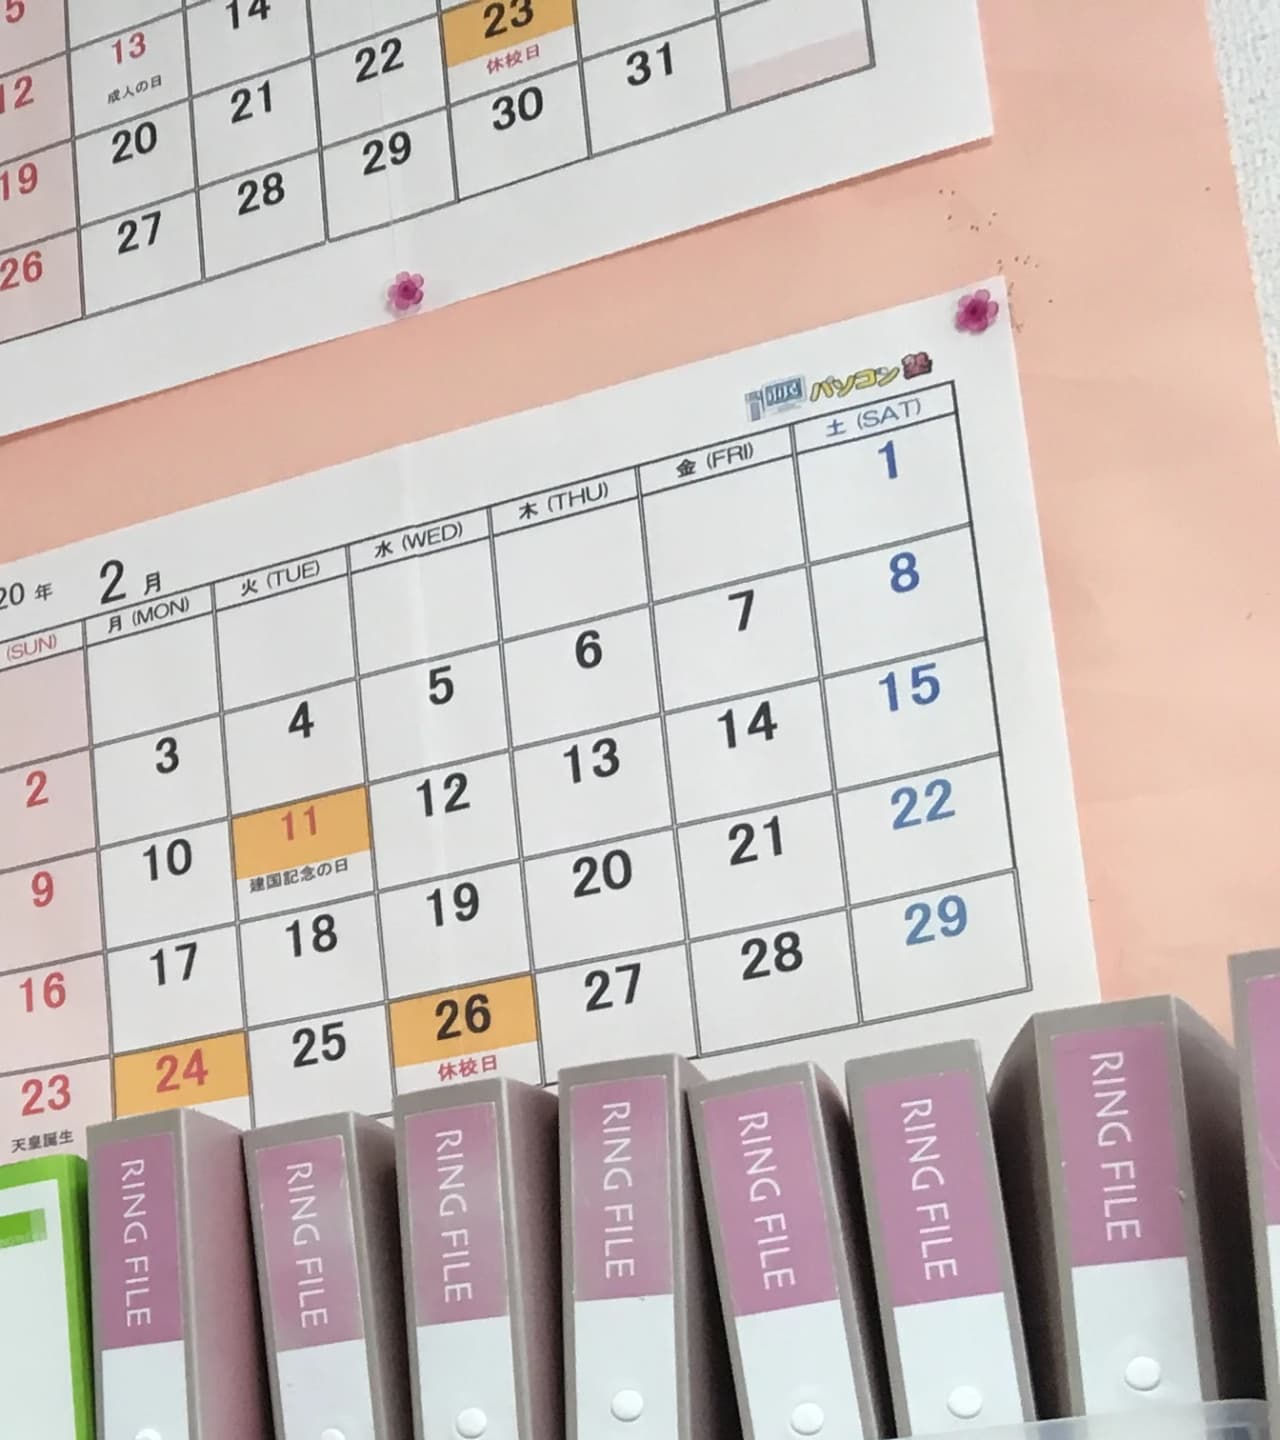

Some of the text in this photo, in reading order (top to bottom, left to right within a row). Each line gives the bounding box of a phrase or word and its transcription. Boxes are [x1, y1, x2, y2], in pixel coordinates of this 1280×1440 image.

[5, 0, 25, 24] 5
[228, 0, 271, 30] 14
[483, 0, 535, 39] 23
[111, 33, 146, 65] 13
[355, 38, 404, 83] 22
[485, 44, 541, 75] 休校日
[626, 42, 673, 86] 31
[107, 75, 162, 104] 成人の日
[230, 81, 273, 124] 21
[492, 86, 544, 131] 30
[111, 122, 158, 164] 20
[362, 131, 412, 176] 29
[237, 171, 285, 215] 28
[116, 211, 162, 254] 27
[0, 251, 44, 291] 26
[877, 441, 898, 479] 1
[889, 552, 920, 592] 8
[728, 590, 755, 631] 7
[575, 631, 603, 669] 6
[428, 666, 454, 706] 5
[879, 663, 941, 712] 15
[287, 702, 315, 739] 4
[717, 701, 778, 749] 14
[155, 737, 180, 775] 3
[564, 737, 621, 783] 13
[25, 770, 49, 807] 2
[416, 772, 470, 818] 12
[891, 779, 956, 830] 22
[281, 805, 318, 841] 11
[728, 816, 785, 866] 21
[143, 838, 193, 881] 10
[249, 857, 349, 894] 建国記念の日
[572, 849, 633, 898] 20
[31, 871, 55, 908] 9
[426, 881, 480, 927] 19
[285, 914, 338, 958] 18
[904, 895, 968, 946] 29
[149, 942, 198, 986] 17
[741, 930, 804, 980] 28
[19, 972, 67, 1013] 16
[584, 963, 642, 1012] 27
[435, 994, 492, 1041] 26
[292, 1022, 347, 1068] 25
[155, 1048, 208, 1094] 24
[437, 1055, 498, 1082] 休校日
[21, 1074, 72, 1117] 23
[1090, 1050, 1141, 1242] RING FILE
[601, 1101, 636, 1279] RING FILE
[738, 1111, 796, 1291] RING FILE
[900, 1098, 959, 1281] RING FILE
[435, 1129, 472, 1303] RING FILE
[121, 1158, 151, 1327] RING FILE
[285, 1161, 328, 1329] RING FILE
